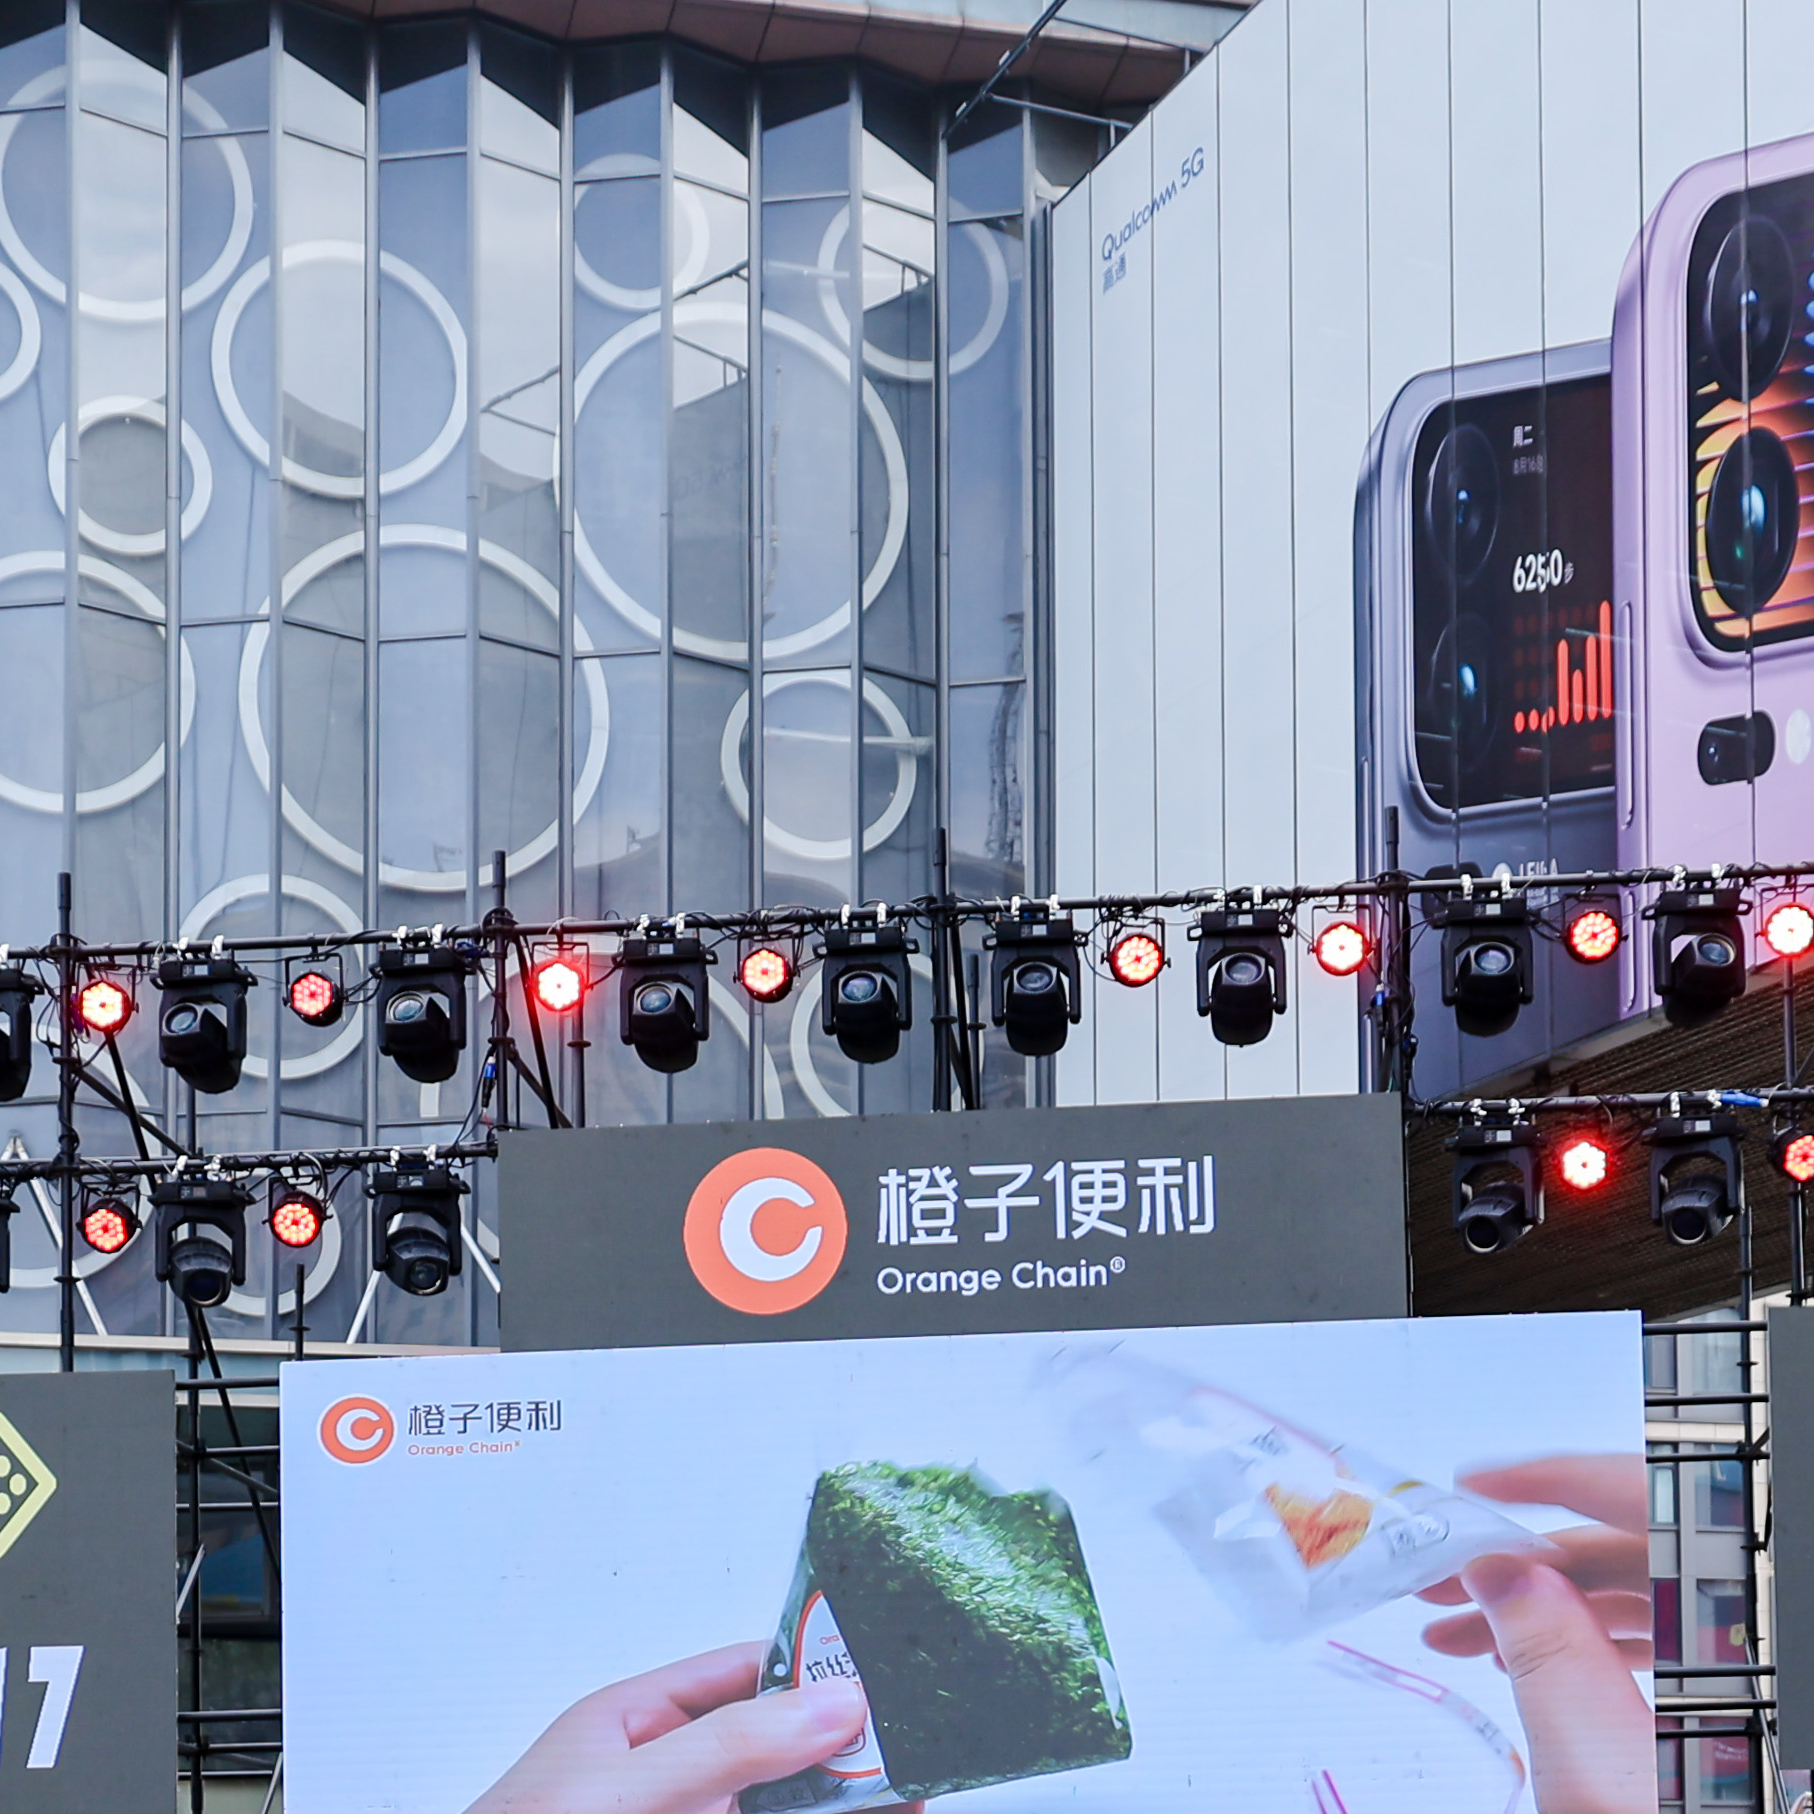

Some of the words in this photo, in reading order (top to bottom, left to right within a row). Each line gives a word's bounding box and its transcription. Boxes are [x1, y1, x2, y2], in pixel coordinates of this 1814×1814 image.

[1101, 179, 1178, 262] Qualcomm
[1181, 146, 1204, 189] 5G
[876, 1154, 1216, 1247] 橙子便利
[876, 1266, 1003, 1297] Orange
[407, 1399, 563, 1436] 橙子便利
[407, 1443, 465, 1457] Orange
